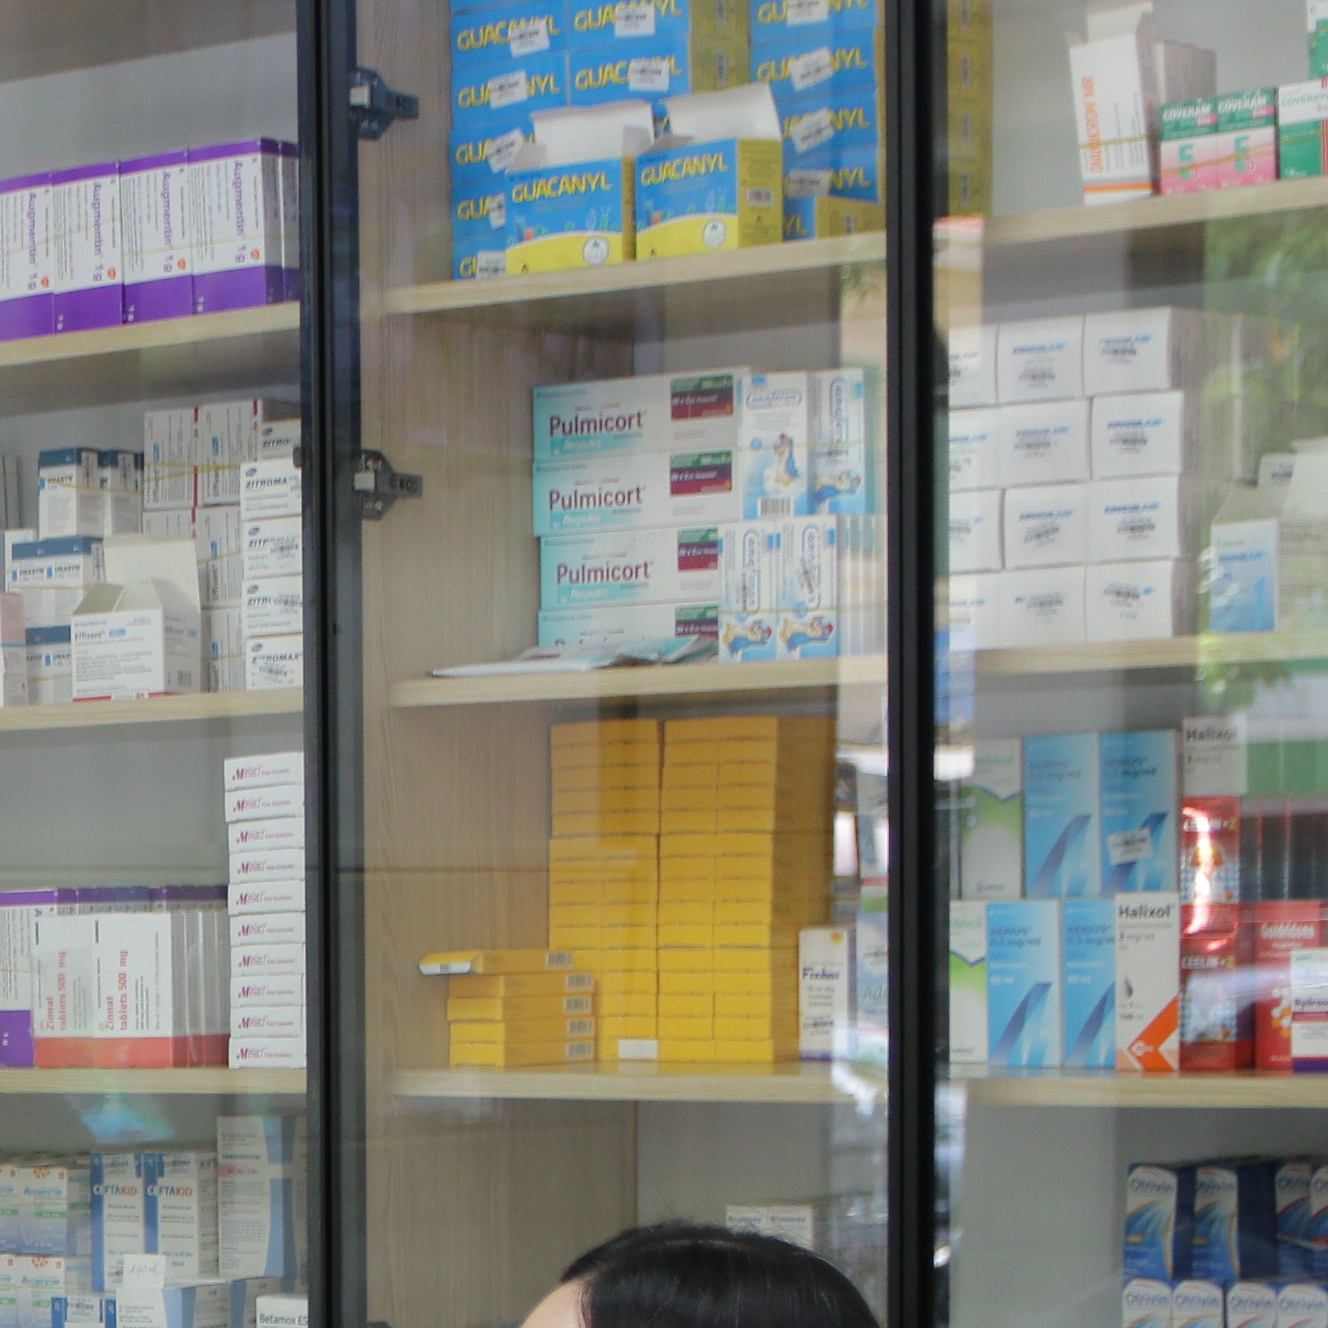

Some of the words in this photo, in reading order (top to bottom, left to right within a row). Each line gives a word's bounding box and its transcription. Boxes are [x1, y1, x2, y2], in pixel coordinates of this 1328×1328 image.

[640, 151, 730, 187] GUACANYL
[231, 161, 244, 236] Augmentin
[511, 171, 613, 204] GUACANYL
[91, 183, 104, 256] Augmentin
[160, 171, 173, 246] Augmentin
[26, 192, 38, 265] Augmentin
[549, 410, 645, 438] Pulmicort
[548, 486, 645, 513] Pulmicort
[556, 561, 652, 587] Pulmicort
[1118, 904, 1172, 919] Halixol
[57, 951, 67, 968] mg
[119, 950, 129, 967] mg
[57, 973, 66, 991] 500
[119, 972, 128, 991] 500
[45, 996, 54, 1031] Zinnat
[58, 993, 67, 1031] tablets
[106, 996, 114, 1031] Zinnat
[119, 993, 128, 1031] tablets
[92, 1185, 138, 1198] CEFTAKID
[146, 1185, 194, 1198] CEFTAKID
[258, 1312, 296, 1326] Betamox
